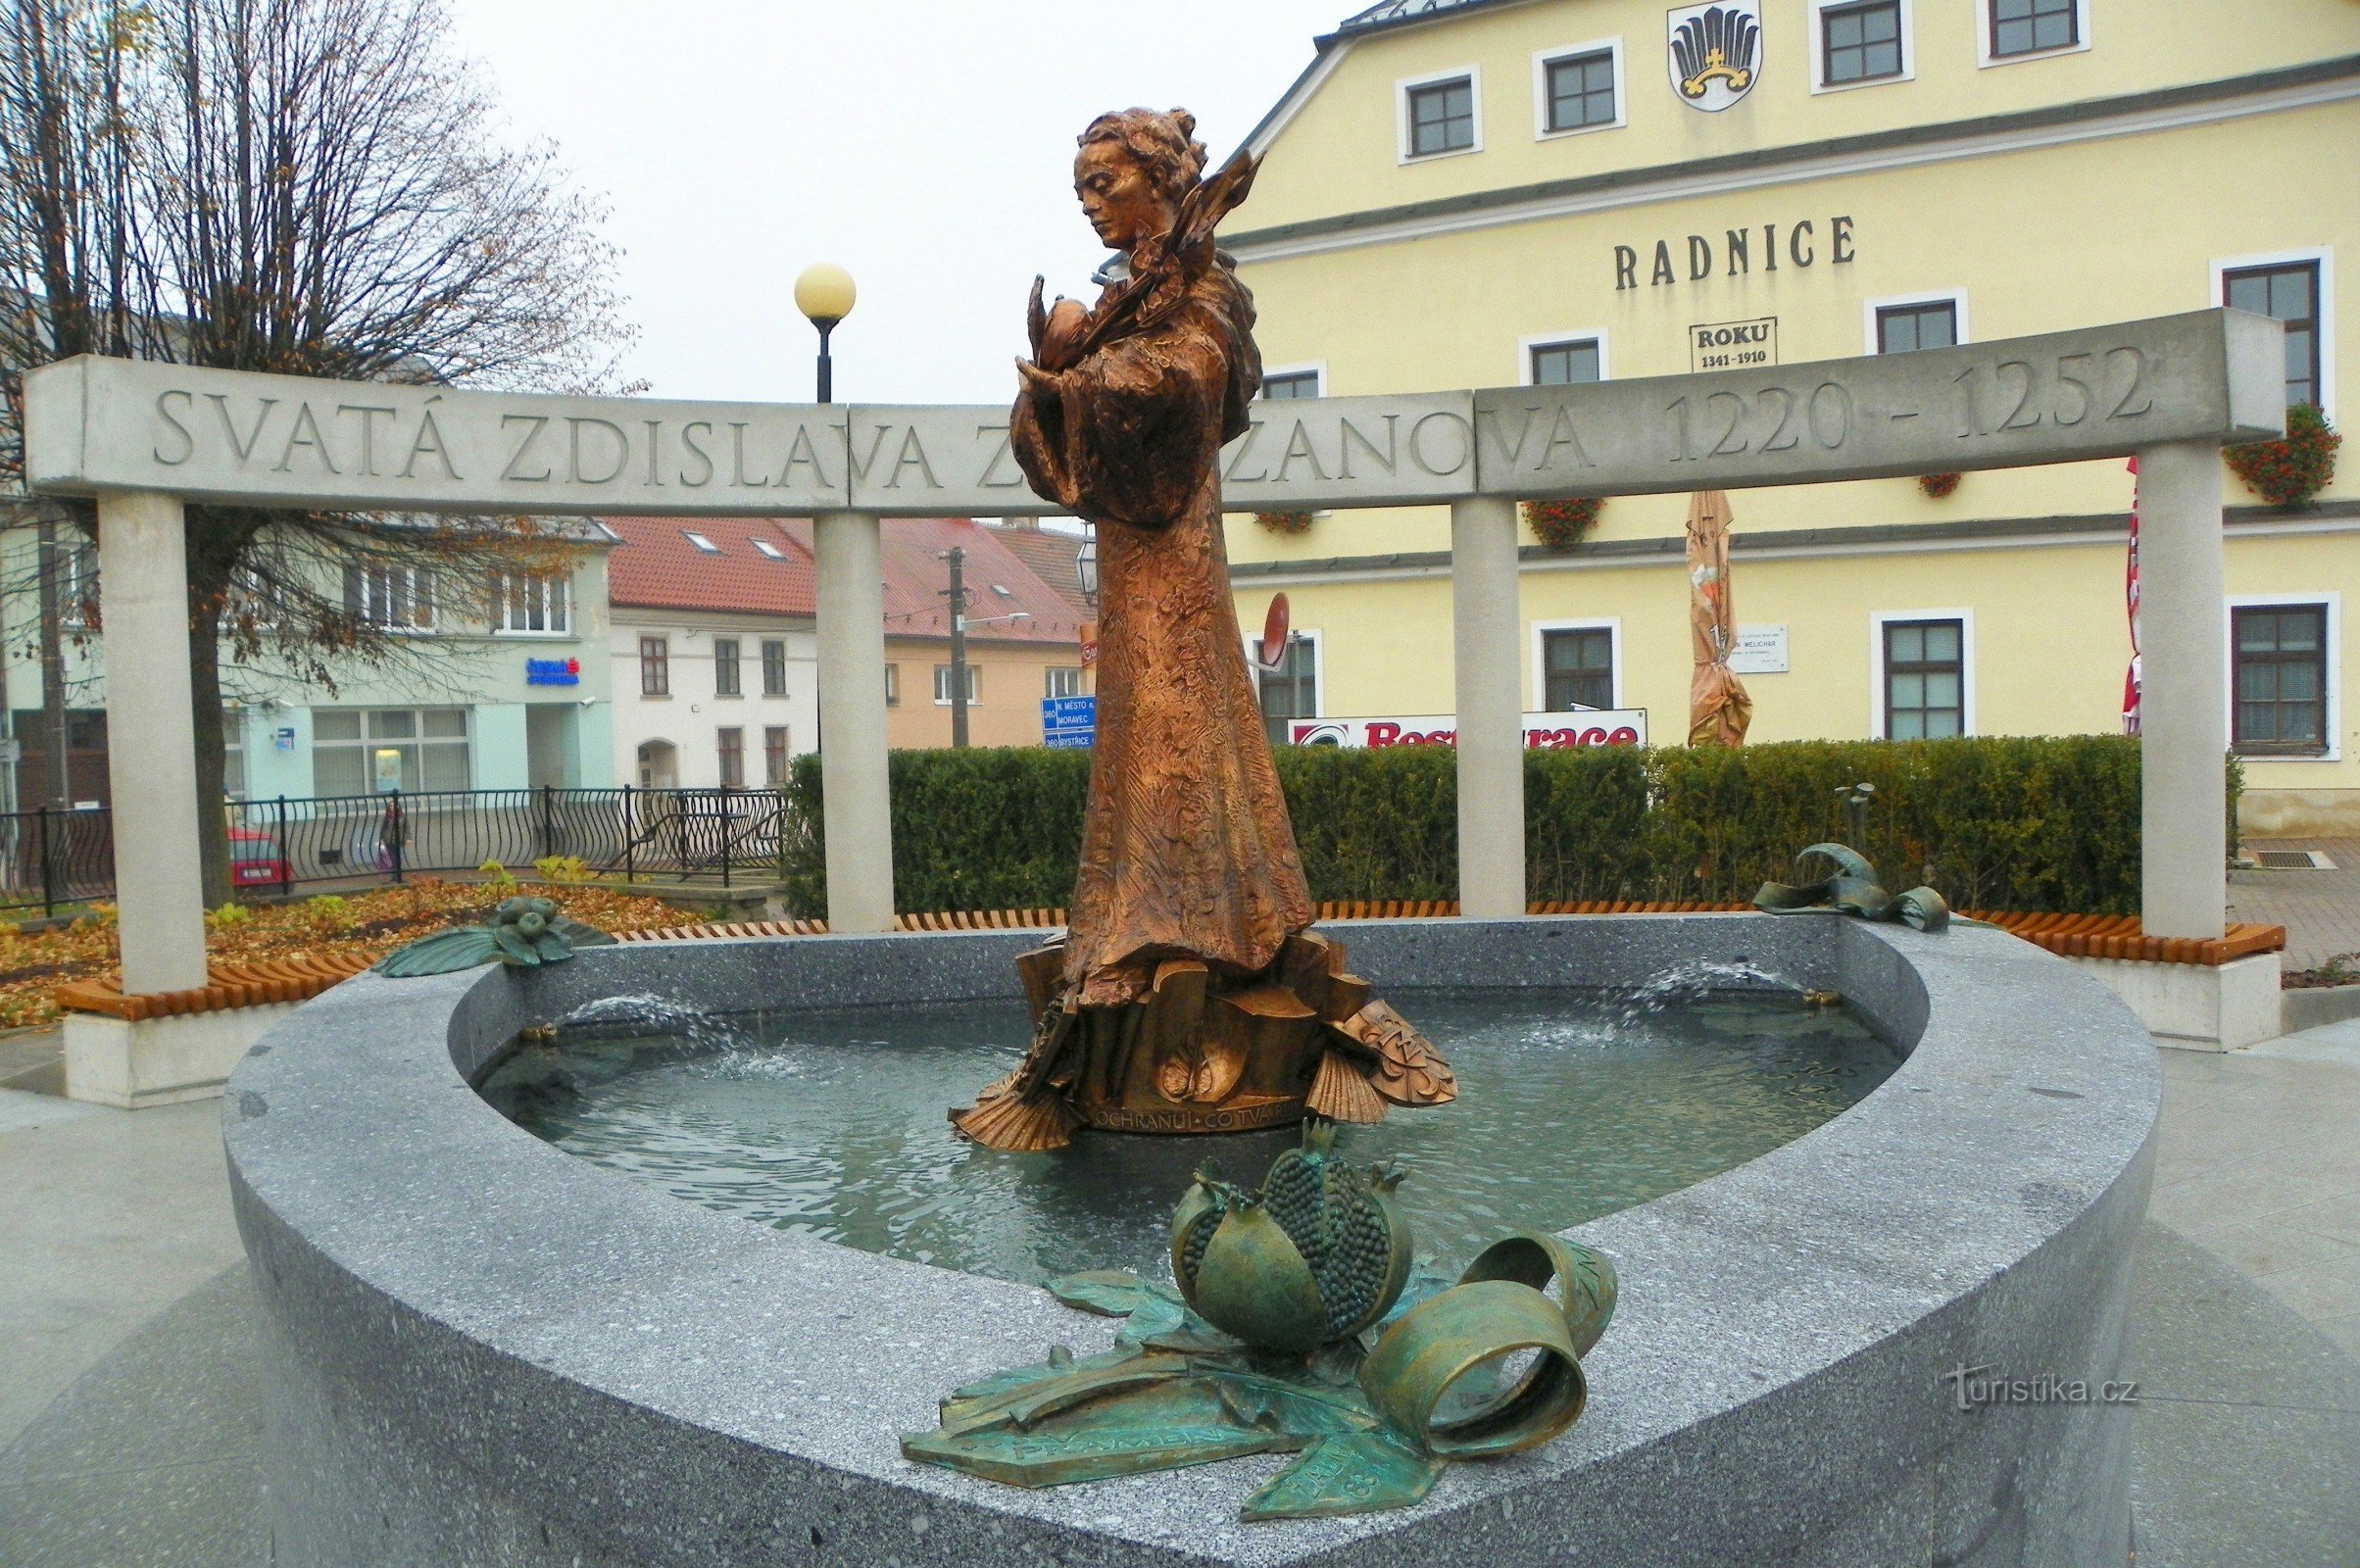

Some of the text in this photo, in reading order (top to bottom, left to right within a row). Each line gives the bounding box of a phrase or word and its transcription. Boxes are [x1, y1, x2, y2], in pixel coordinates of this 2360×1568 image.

[1614, 216, 1855, 290] RADNICE
[1697, 323, 1769, 348] ROKU
[1702, 350, 1766, 368] 1341-1910
[153, 389, 464, 480] SVATÁ
[499, 414, 944, 489] ZDISLAVA
[1666, 382, 1853, 462] 1220
[1953, 346, 2153, 438] 1252
[1064, 701, 1086, 710] MĚSTO
[1058, 714, 1088, 724] MORAVEC
